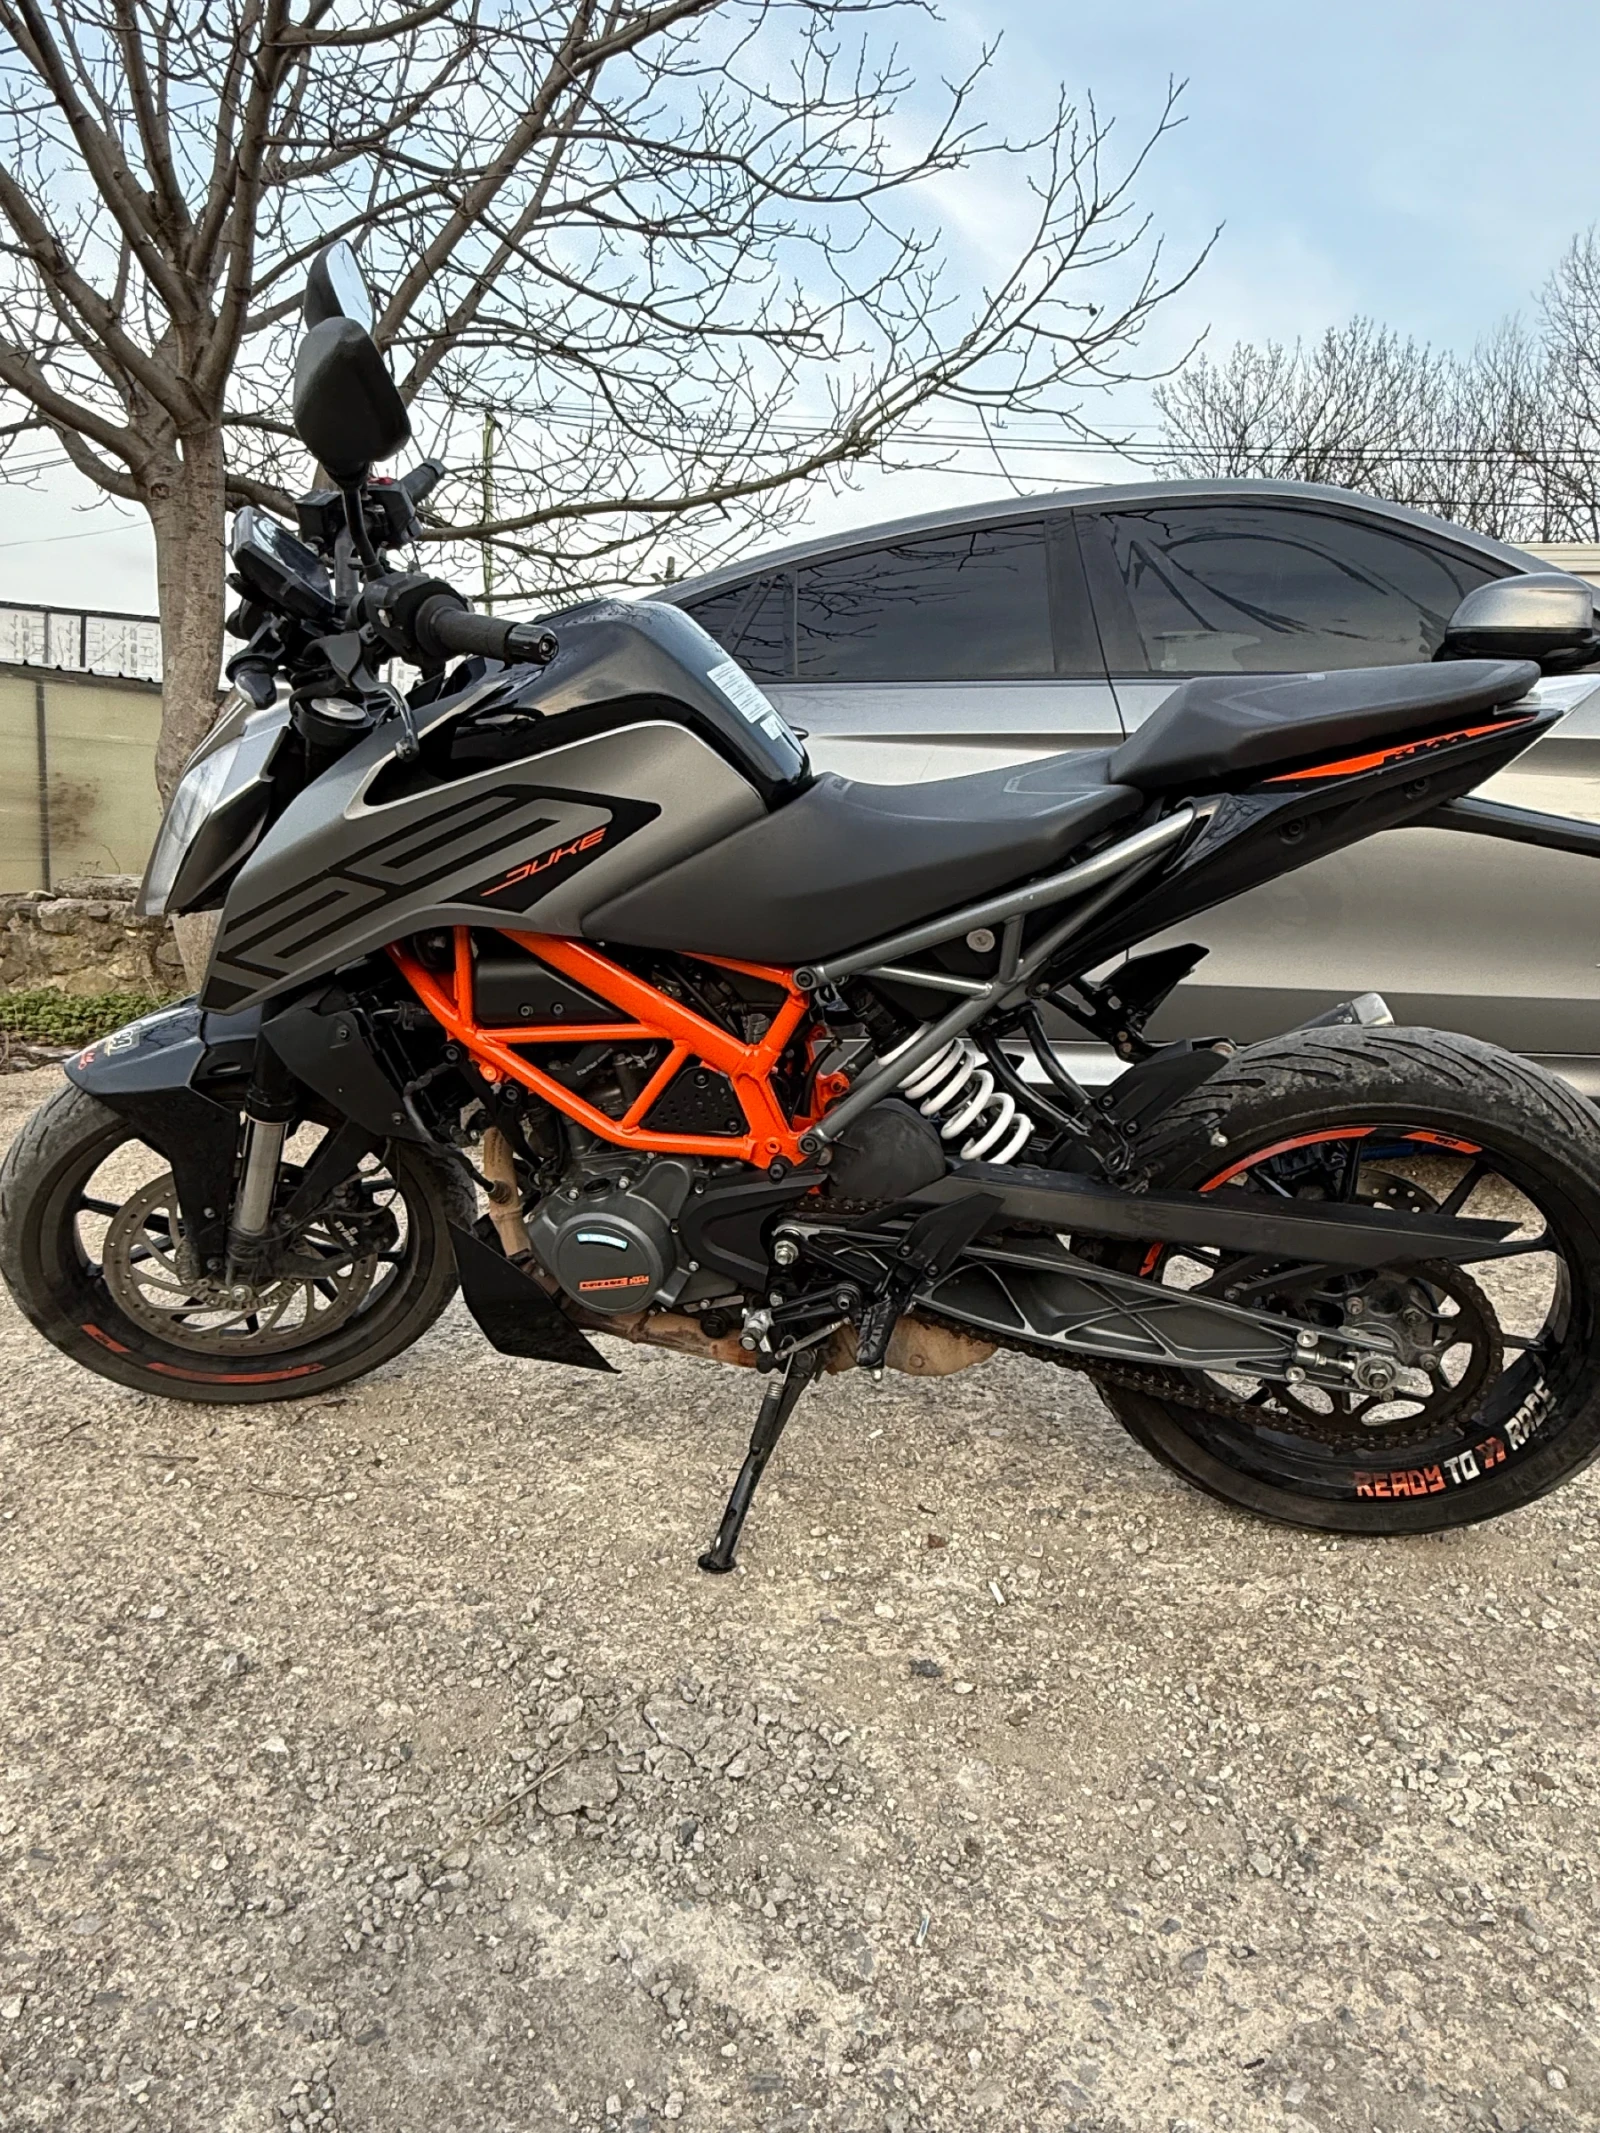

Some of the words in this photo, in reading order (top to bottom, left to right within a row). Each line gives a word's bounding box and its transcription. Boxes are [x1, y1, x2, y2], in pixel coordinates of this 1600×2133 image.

[480, 827, 607, 897] DUKE
[1353, 1464, 1447, 1497] READY
[1444, 1450, 1481, 1484] TO
[1504, 1376, 1557, 1451] RACE
